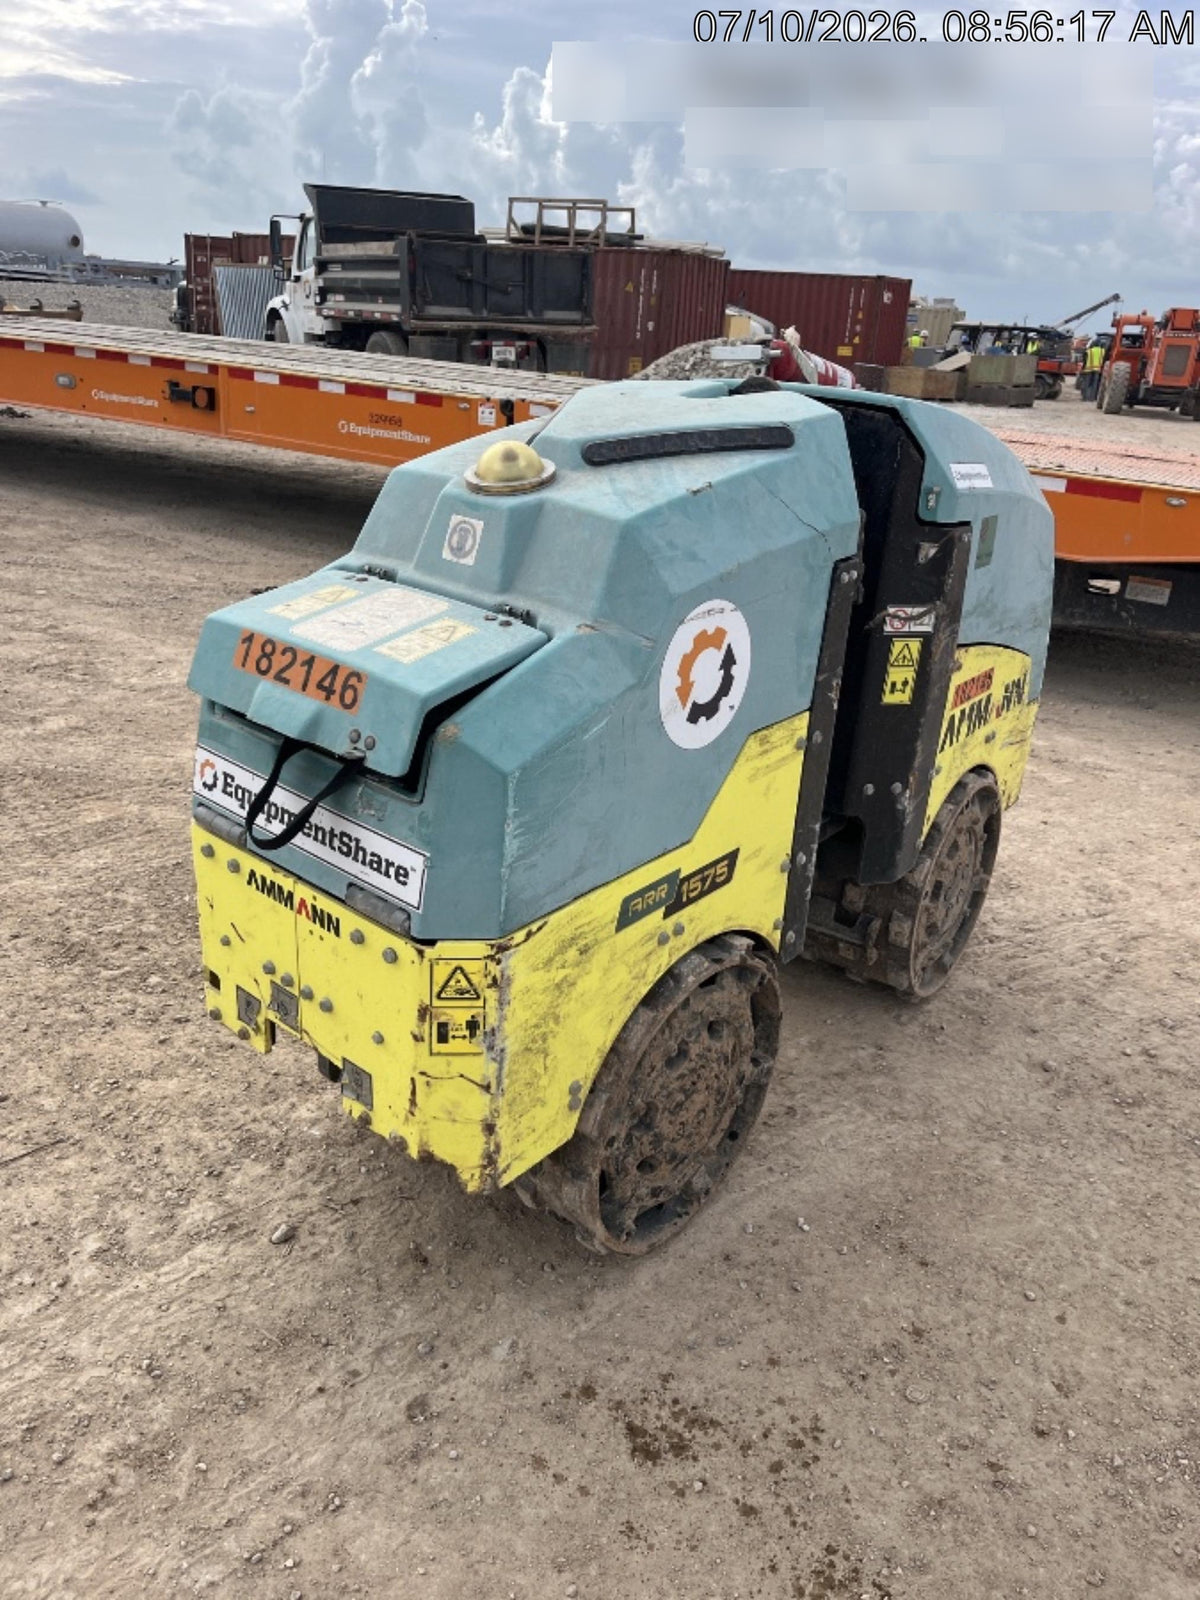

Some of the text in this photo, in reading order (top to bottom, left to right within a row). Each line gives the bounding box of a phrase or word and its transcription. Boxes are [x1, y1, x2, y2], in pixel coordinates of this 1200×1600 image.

[238, 632, 363, 711] 182146
[247, 868, 341, 938] AMMANN
[629, 859, 729, 917] ARR 1575
